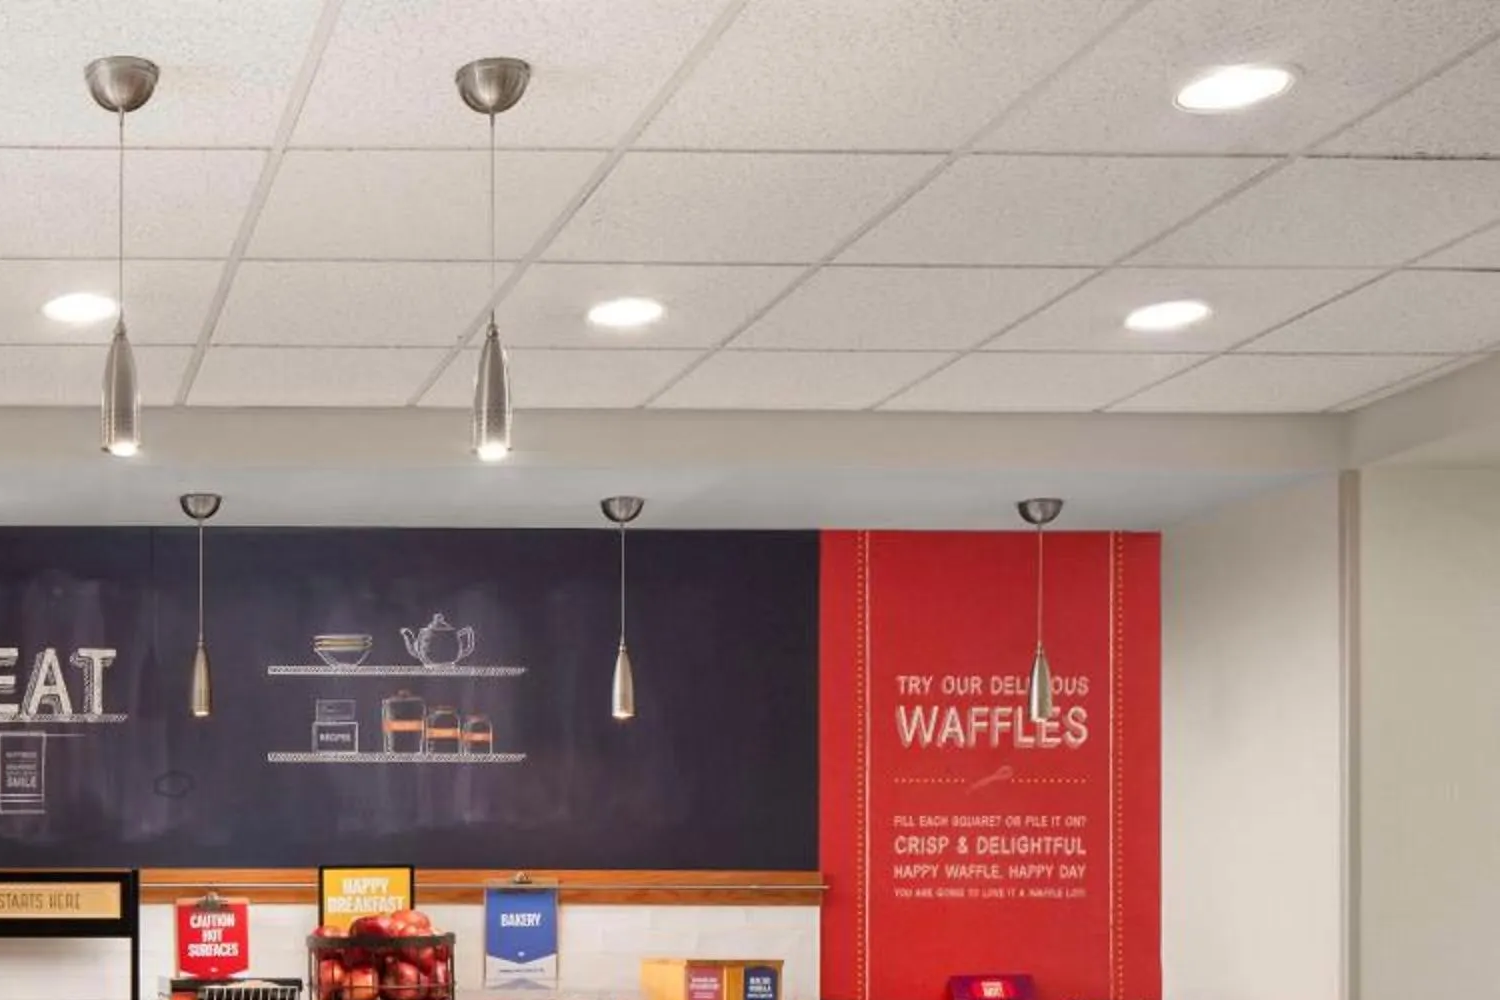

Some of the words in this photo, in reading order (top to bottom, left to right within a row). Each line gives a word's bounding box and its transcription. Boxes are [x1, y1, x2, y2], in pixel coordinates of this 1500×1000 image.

[896, 675, 933, 696] TRY
[942, 675, 983, 696] OUR
[896, 705, 1089, 748] WAFFLES
[894, 815, 915, 828] FILL
[919, 815, 949, 828] EACH
[1005, 815, 1022, 828] OR
[1025, 815, 1047, 828] PILE
[1051, 815, 1061, 828] IT
[1065, 815, 1087, 828] ON?
[894, 835, 949, 855] CRISP
[957, 835, 968, 855] &
[977, 835, 1087, 855] DELIGHTFUL
[893, 864, 939, 879] HAPPY
[1009, 864, 1054, 879] HAPPY
[1060, 864, 1087, 879] DAY
[343, 877, 388, 895] HAPPY
[49, 892, 81, 910] HERE
[327, 895, 405, 913] BREAKFAST
[189, 912, 236, 929] CAUTION
[501, 911, 542, 927] BAKERY
[201, 929, 223, 943] HOT
[187, 942, 239, 957] SURFACES
